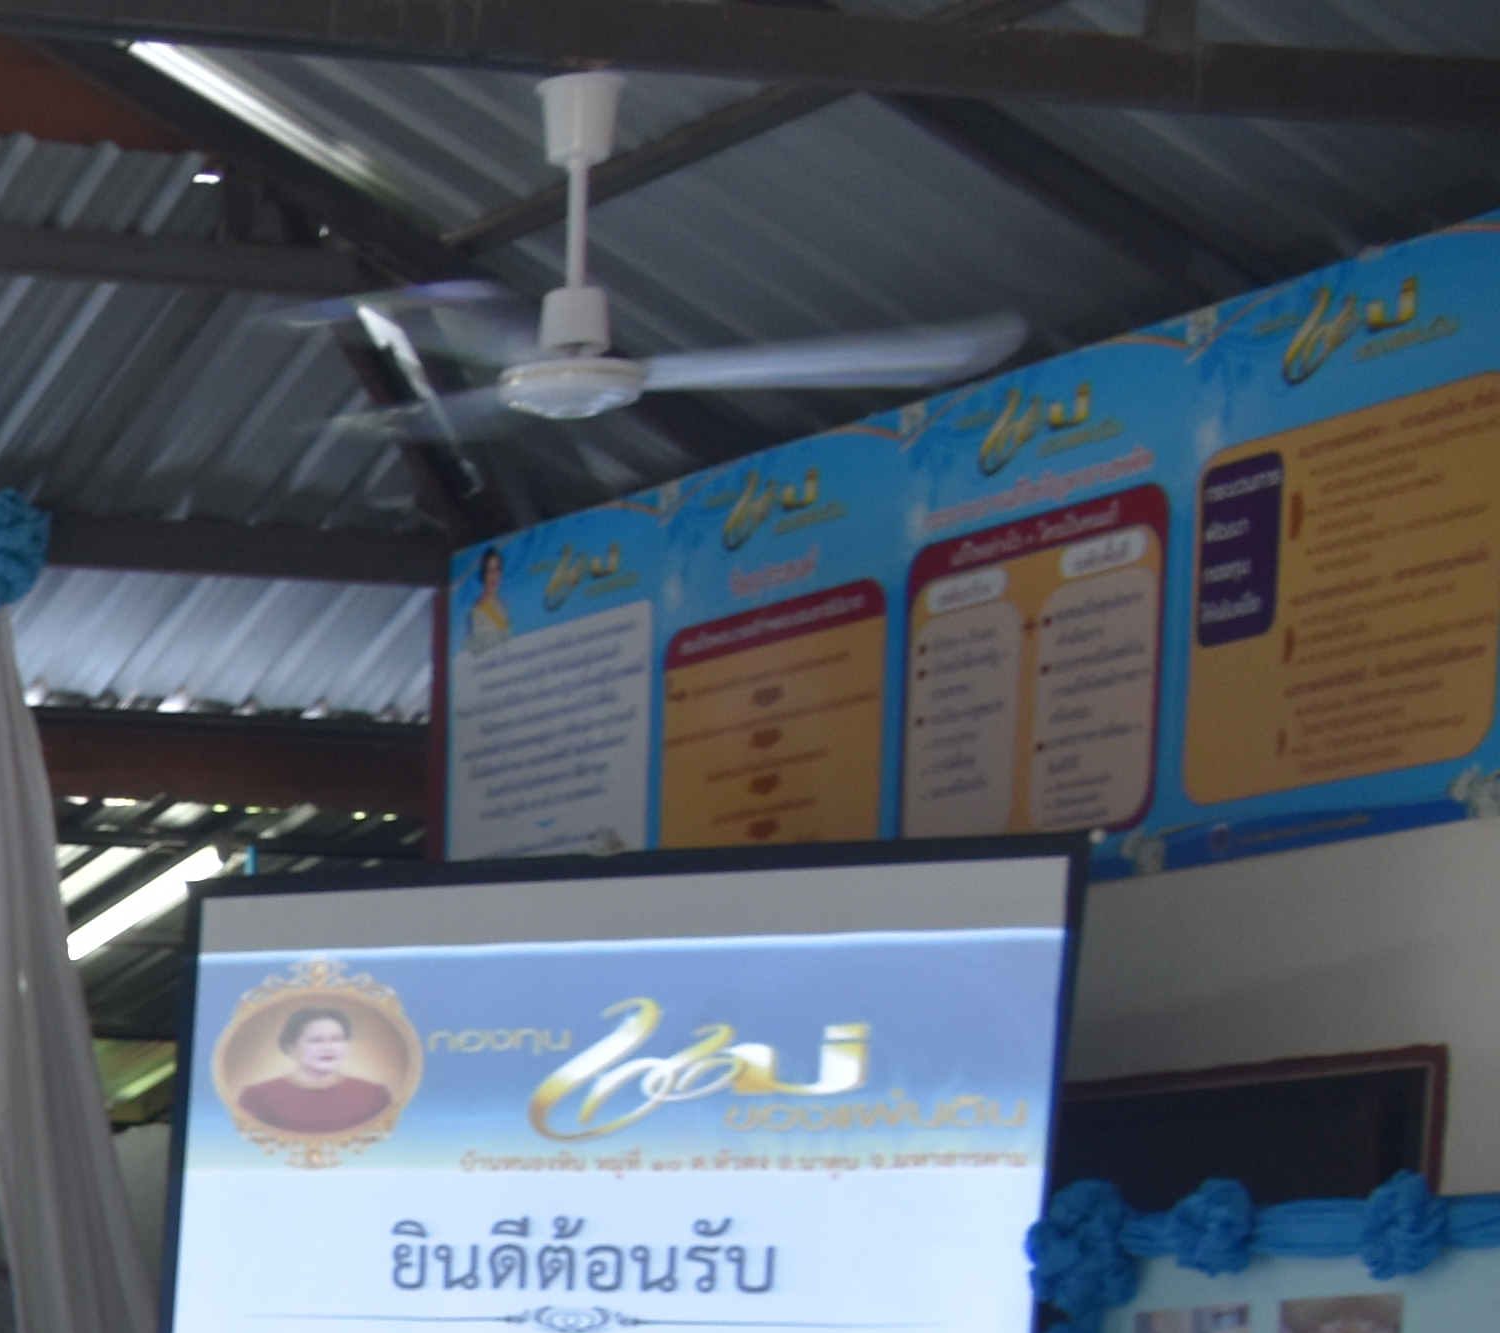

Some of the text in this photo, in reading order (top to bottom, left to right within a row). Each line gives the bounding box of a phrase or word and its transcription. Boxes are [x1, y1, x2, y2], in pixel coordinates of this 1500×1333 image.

[428, 1026, 573, 1057] กองทุน
[722, 1090, 1030, 1133] ของแผ่นดิน
[389, 1215, 779, 1297] ยินดีต้อนรับ
